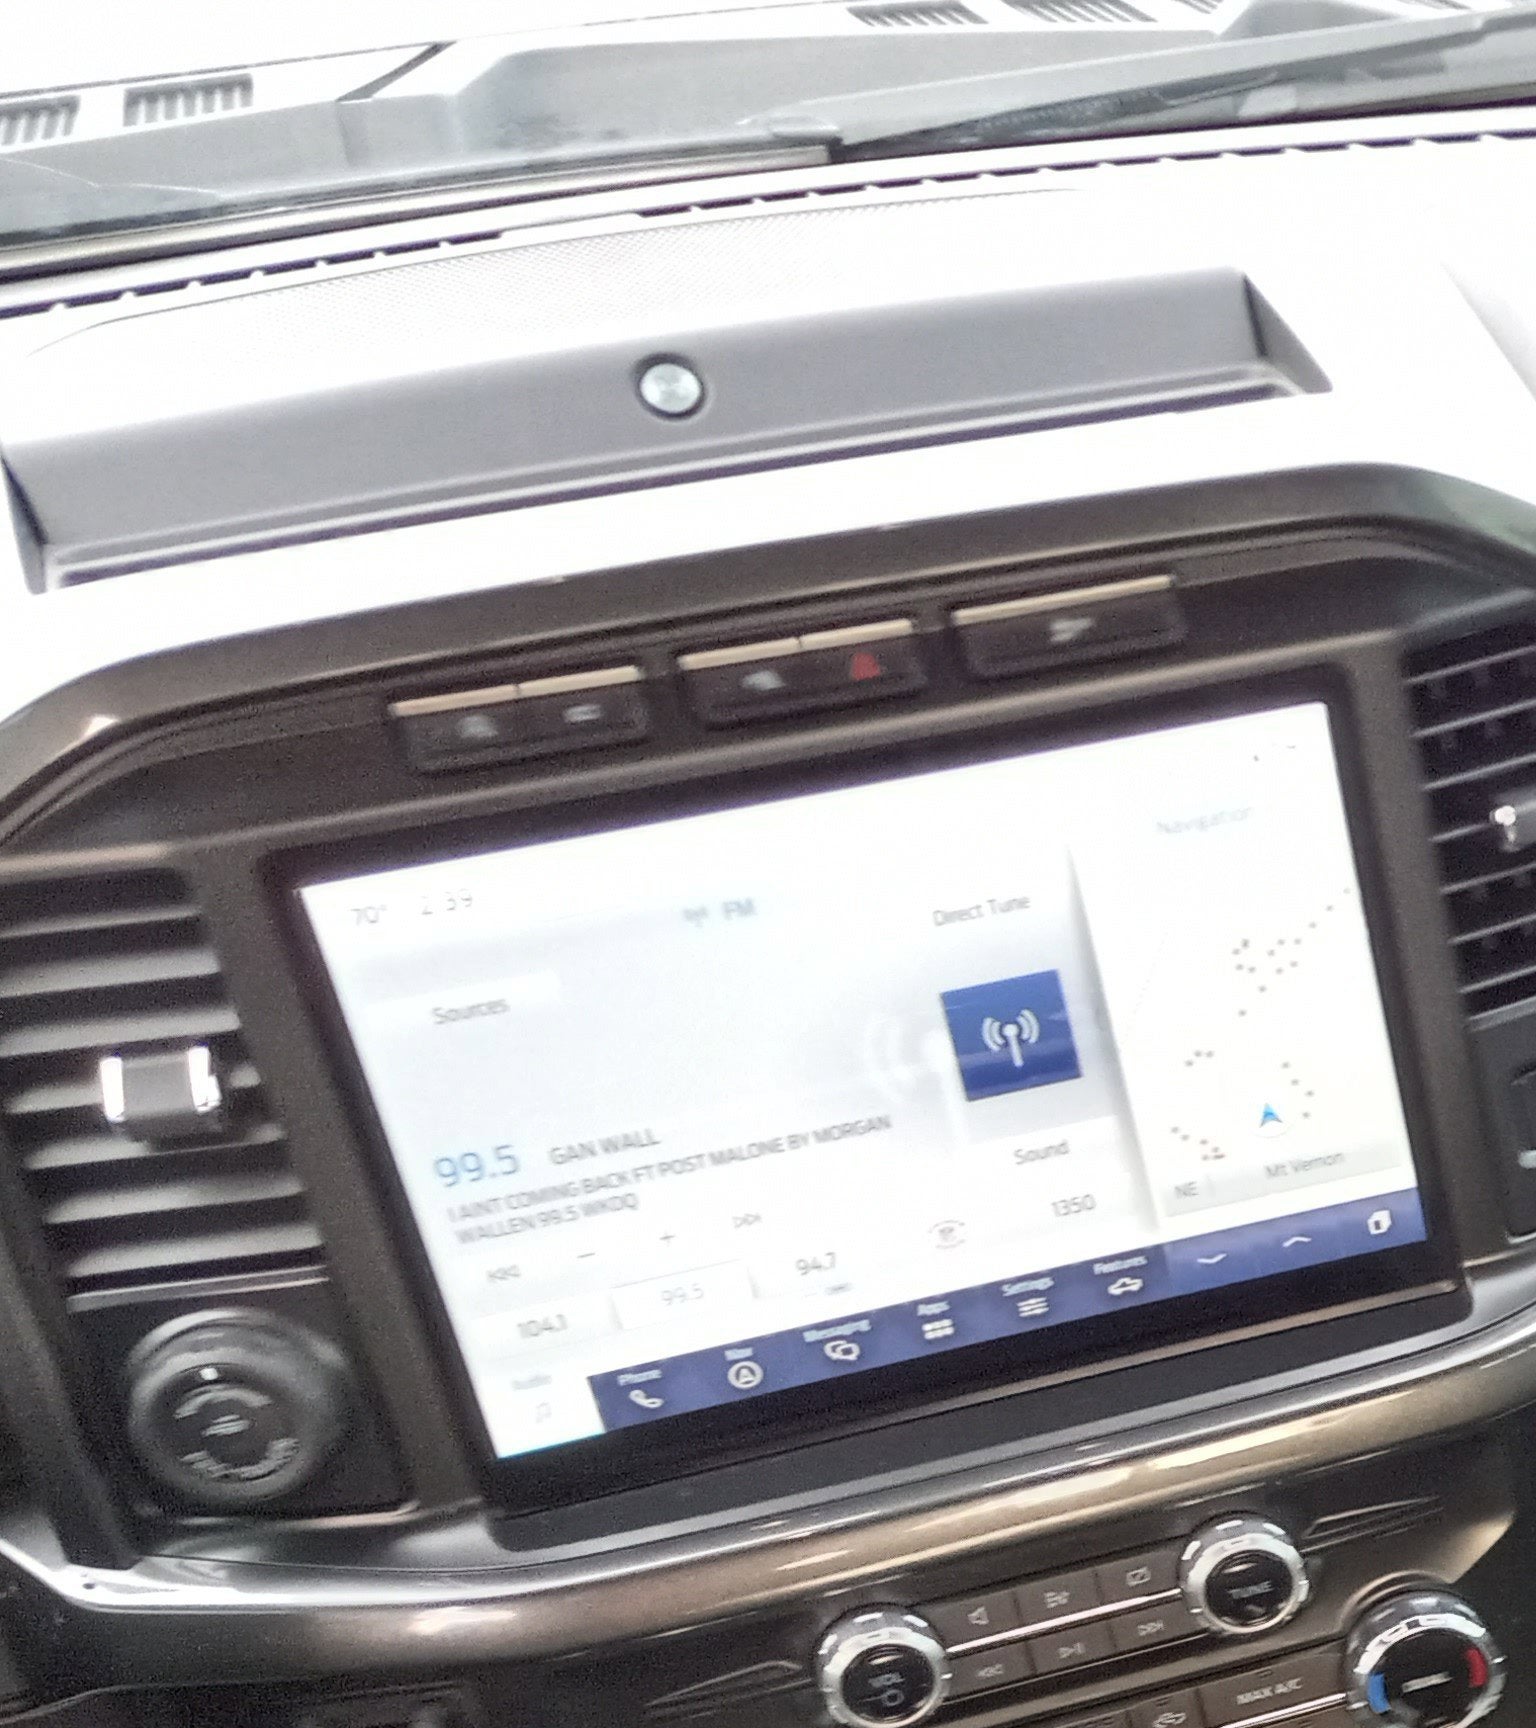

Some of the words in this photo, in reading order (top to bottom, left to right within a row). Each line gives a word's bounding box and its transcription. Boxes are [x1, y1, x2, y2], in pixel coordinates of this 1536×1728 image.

[932, 903, 984, 926] Direct
[986, 896, 1031, 915] Tune
[431, 998, 511, 1025] Sources
[657, 1153, 706, 1177] POST
[707, 1137, 786, 1167] MALONE
[786, 1131, 810, 1151] BY
[811, 1114, 893, 1145] MORGAN
[1012, 1138, 1071, 1165] Sound
[434, 1144, 520, 1188] 99.5
[1174, 1180, 1199, 1200] NE
